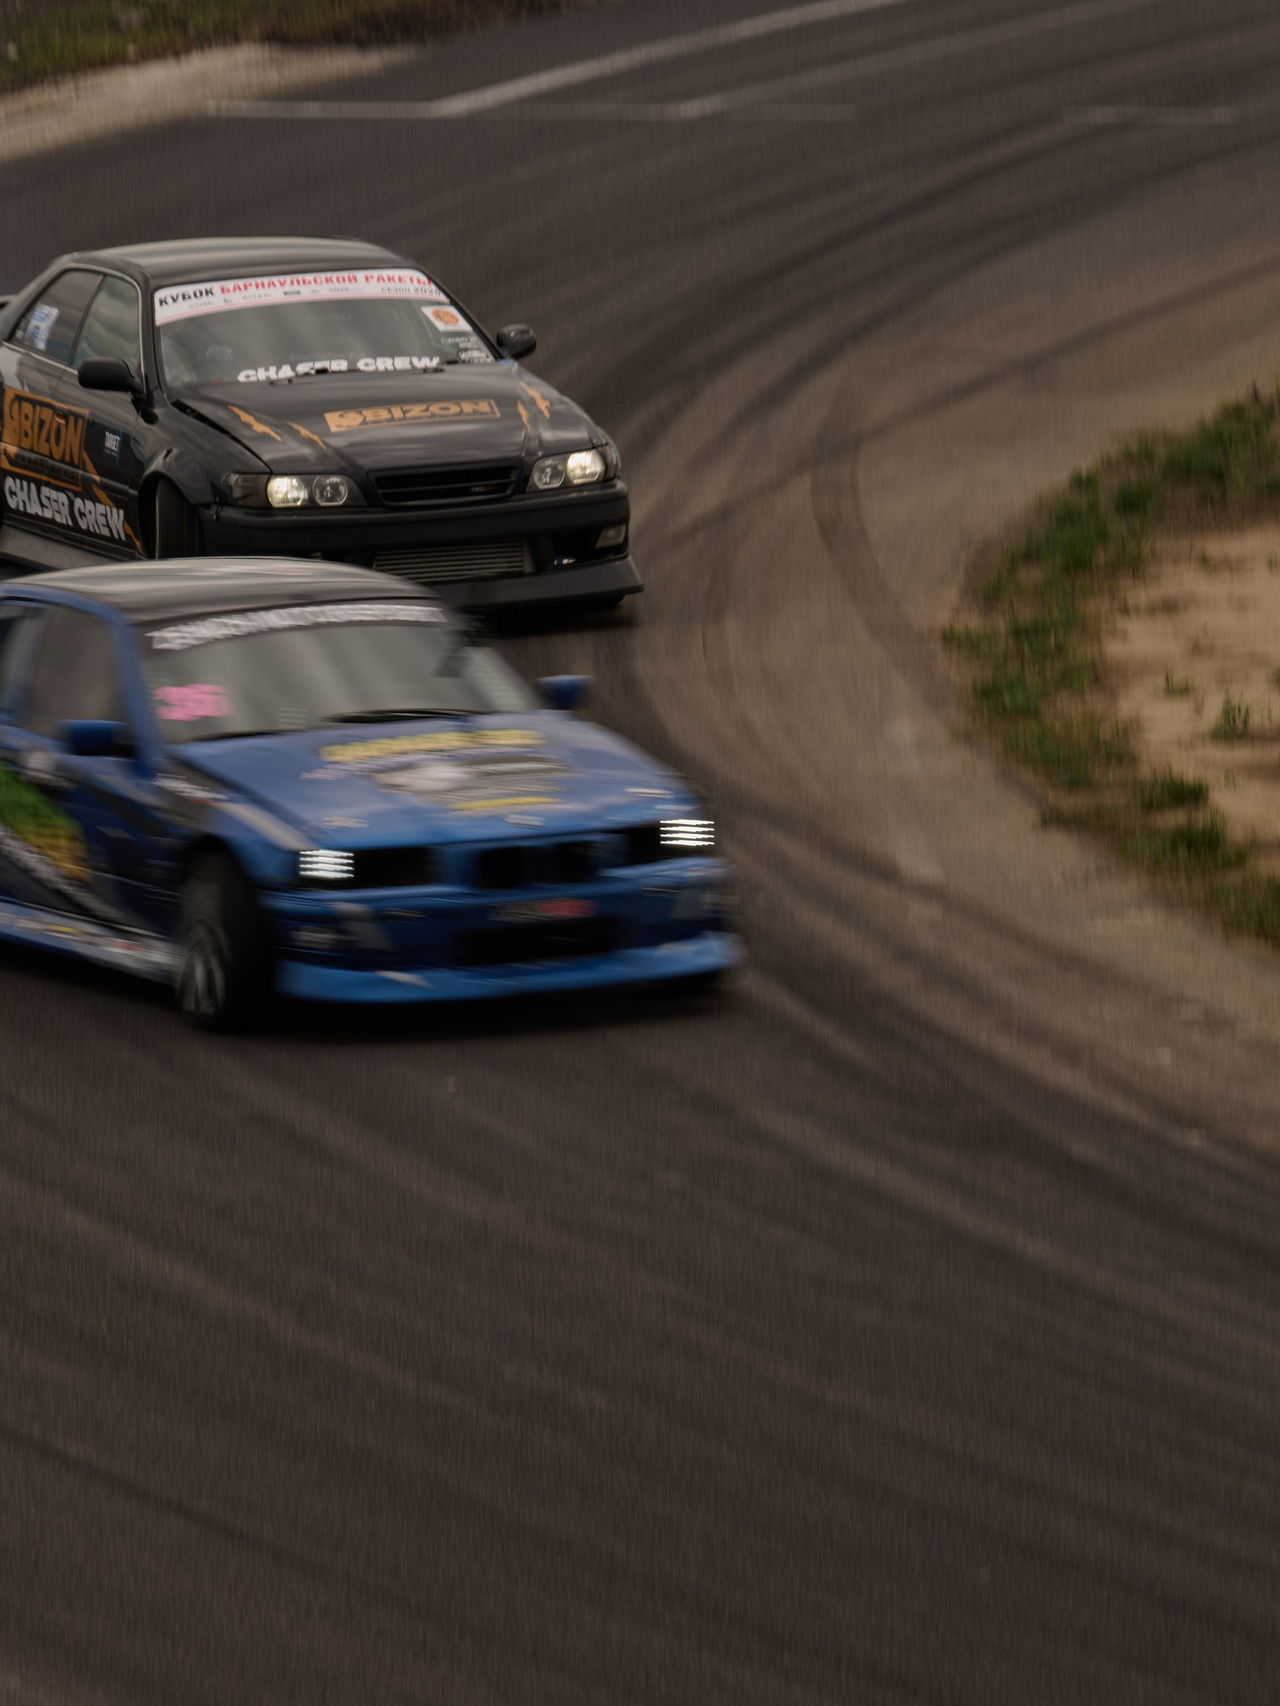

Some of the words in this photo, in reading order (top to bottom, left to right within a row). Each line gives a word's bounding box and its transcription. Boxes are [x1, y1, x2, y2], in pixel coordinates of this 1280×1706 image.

[158, 286, 215, 307] КУБОК
[220, 272, 358, 295] БАРНАУЛЬСКОЙ
[364, 273, 432, 287] РАКЕТЫ
[356, 356, 440, 372] CREW
[365, 401, 492, 422] BIZON
[19, 401, 83, 468] BIZON
[4, 476, 73, 527] CHASER
[73, 495, 126, 541] CREW
